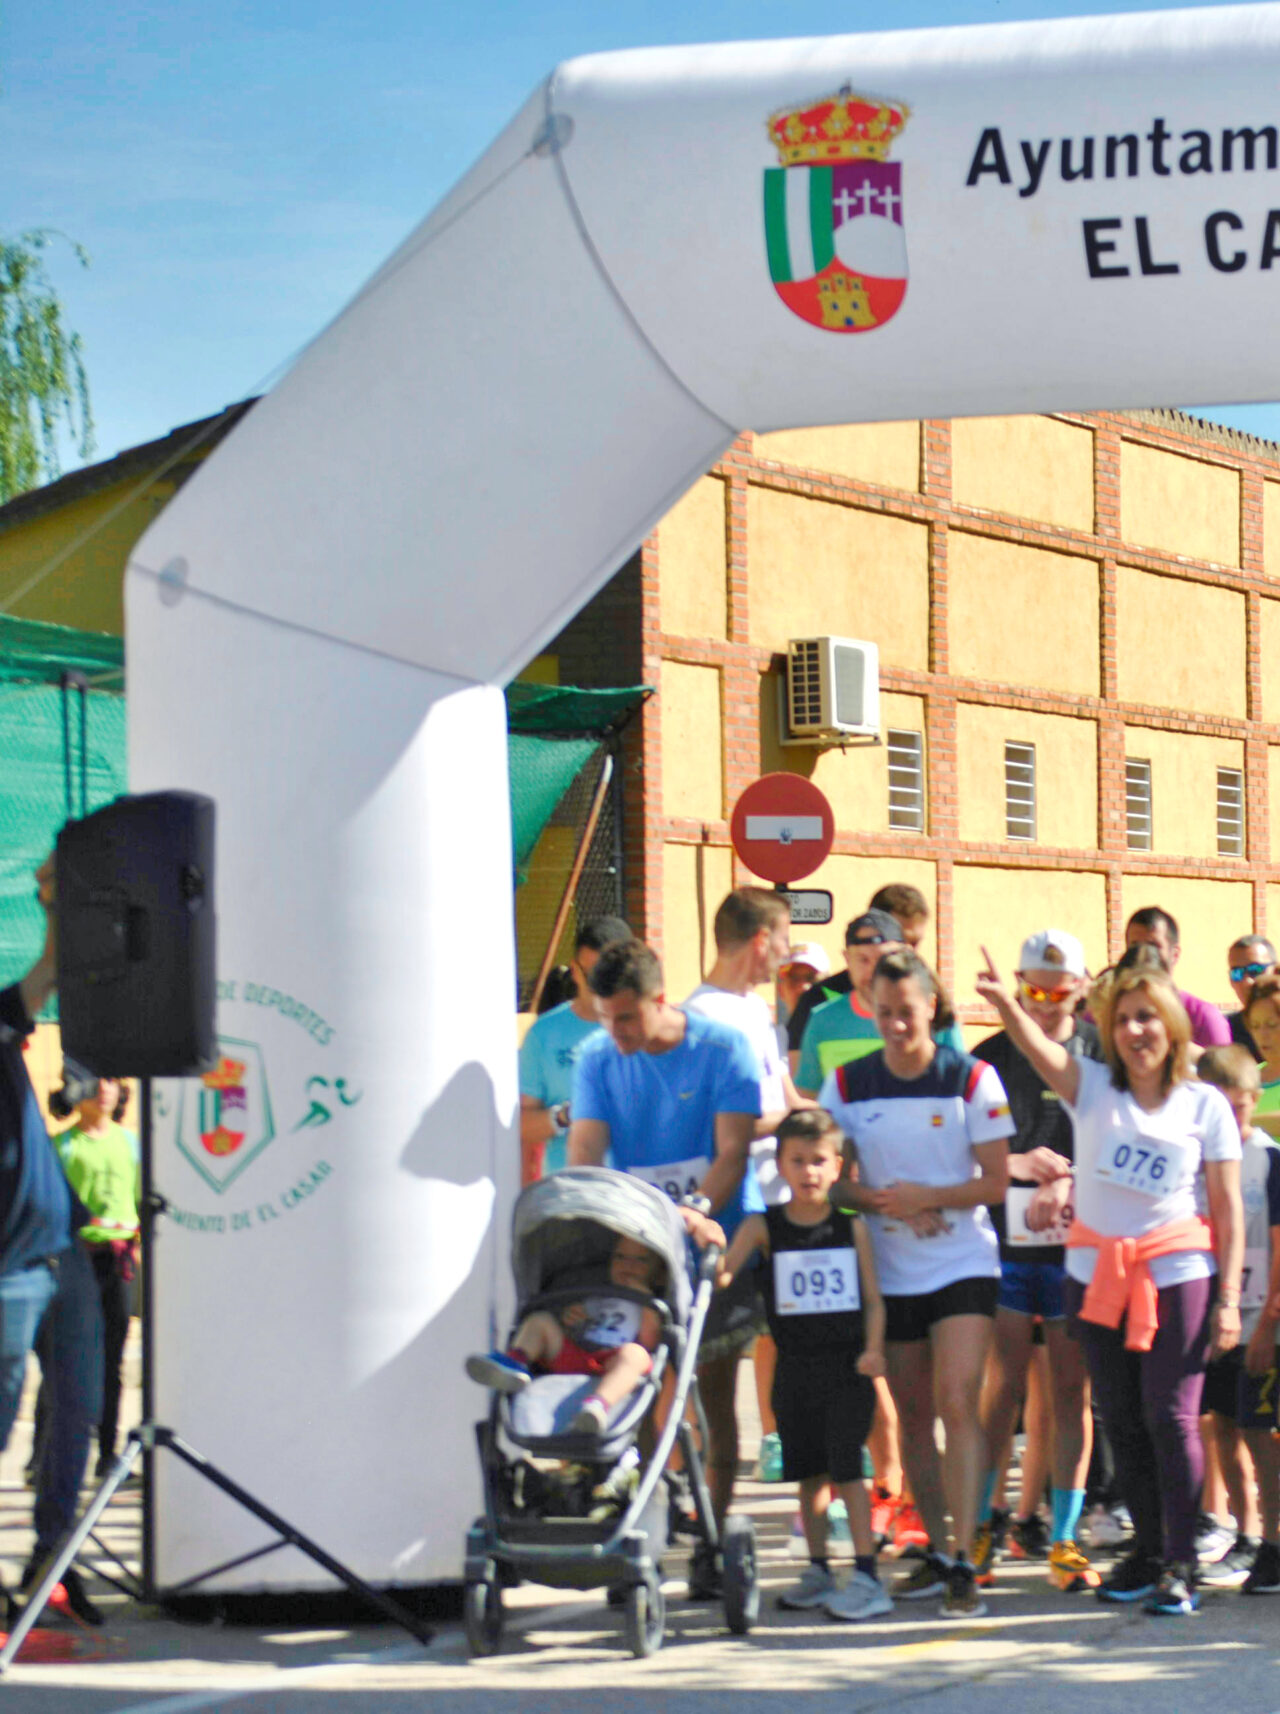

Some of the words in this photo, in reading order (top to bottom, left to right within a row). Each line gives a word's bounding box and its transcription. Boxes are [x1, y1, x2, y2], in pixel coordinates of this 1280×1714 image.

[1082, 216, 1180, 279] EL
[1113, 1143, 1168, 1180] 076
[791, 1267, 845, 1297] 093
